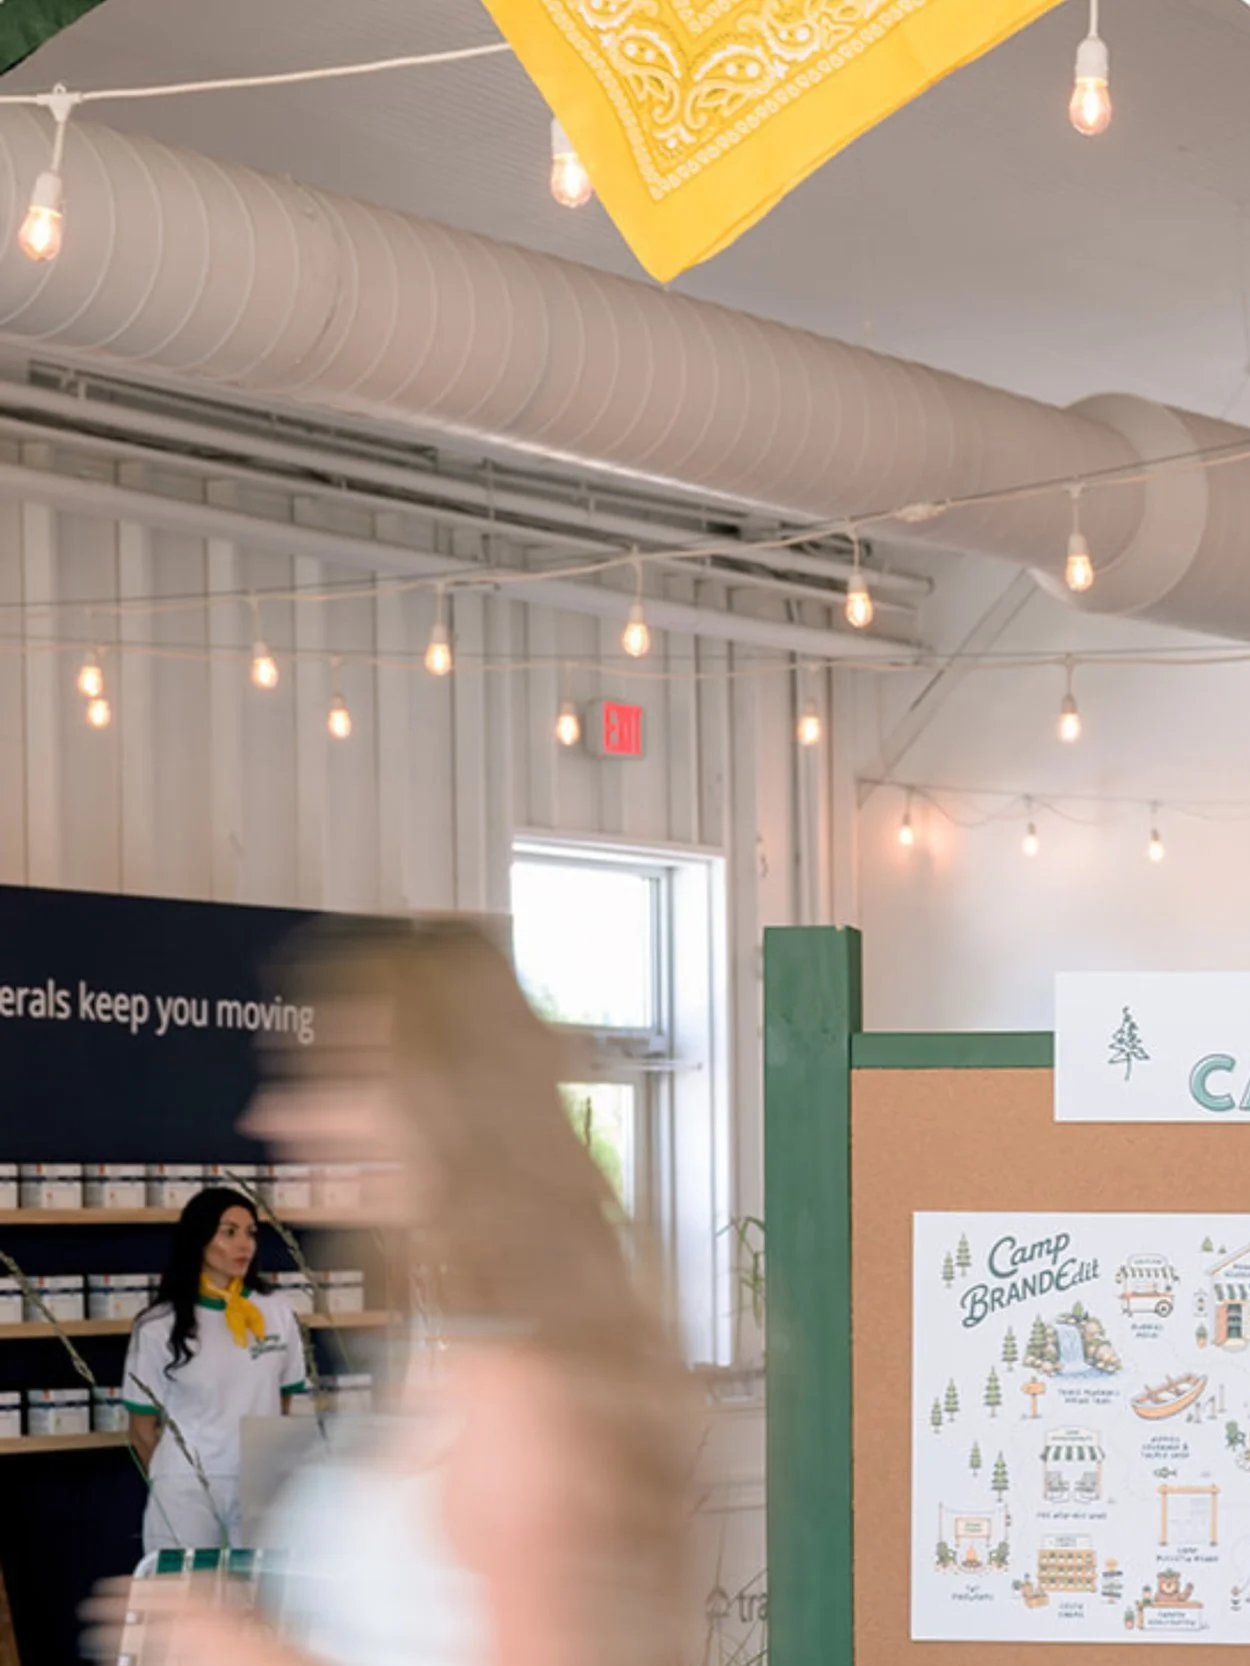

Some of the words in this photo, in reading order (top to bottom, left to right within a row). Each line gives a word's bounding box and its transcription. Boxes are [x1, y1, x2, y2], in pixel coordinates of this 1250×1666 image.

[79, 980, 149, 1034] keep
[155, 996, 208, 1036] you
[216, 996, 314, 1044] moving
[988, 1233, 1070, 1279] Camp
